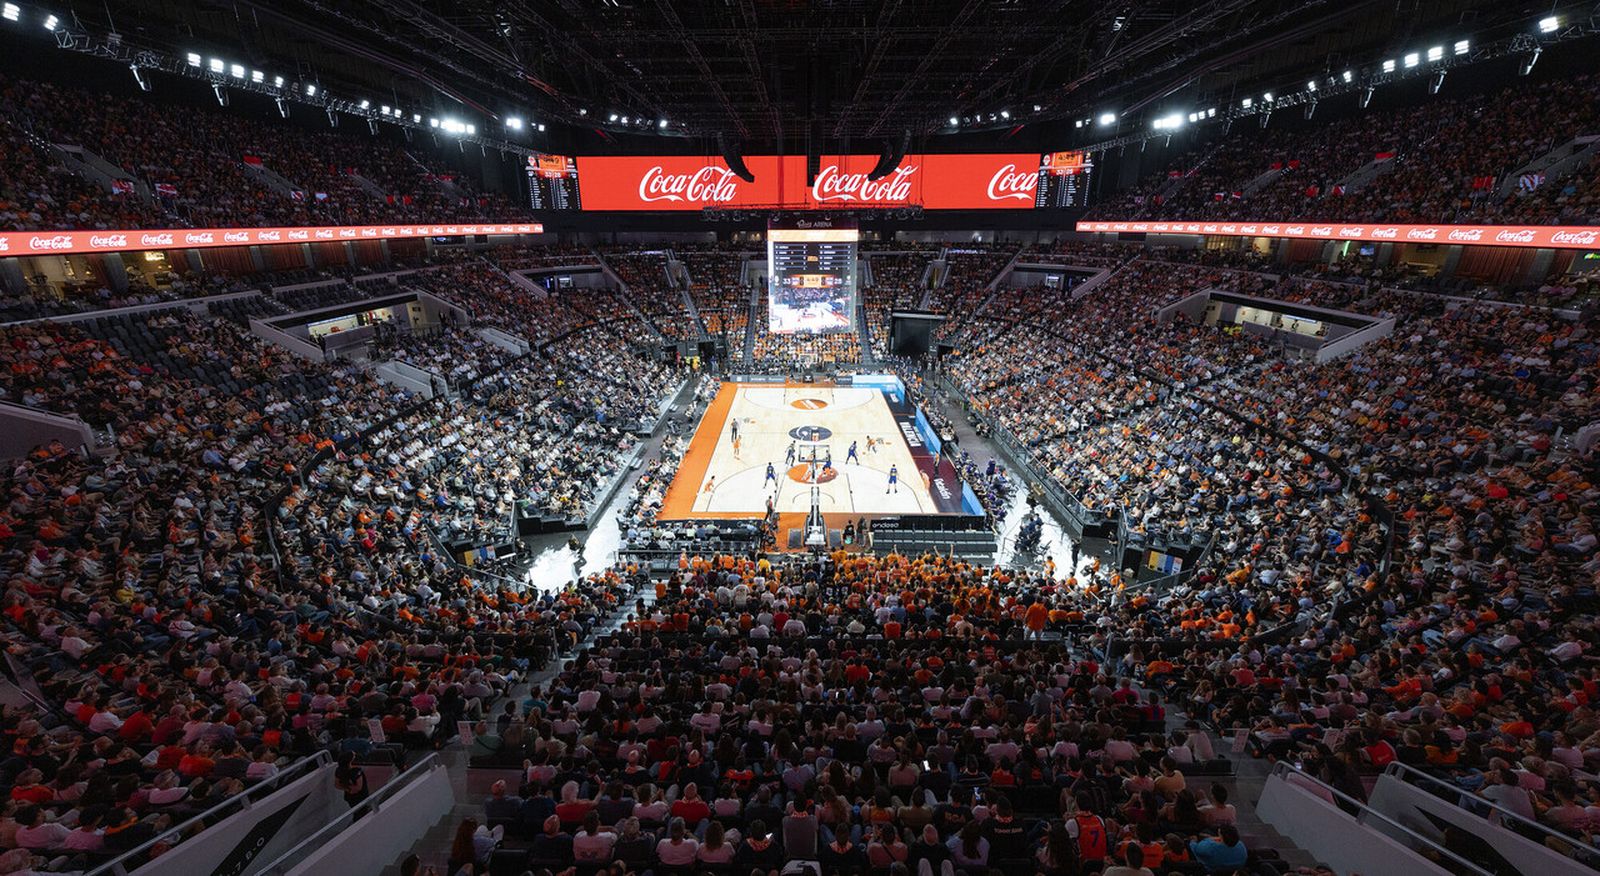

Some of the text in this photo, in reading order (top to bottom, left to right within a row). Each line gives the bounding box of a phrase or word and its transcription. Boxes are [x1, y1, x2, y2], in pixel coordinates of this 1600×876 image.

[639, 166, 738, 202] Coca-Cola
[812, 165, 918, 201] Coca-Cola
[29, 235, 73, 250] Coca-Cola
[90, 234, 127, 248] Coca-Cola
[141, 233, 173, 246] Coca-Cola
[185, 232, 214, 244] Coca-Cola
[1371, 228, 1398, 238] Coca-Cola
[1407, 228, 1439, 239] Coca-Cola
[1448, 229, 1484, 241] Coca-Cola
[1496, 230, 1537, 242] Coca-Cola
[1551, 231, 1599, 244] Coca-Cola
[1090, 829, 1099, 848] 7
